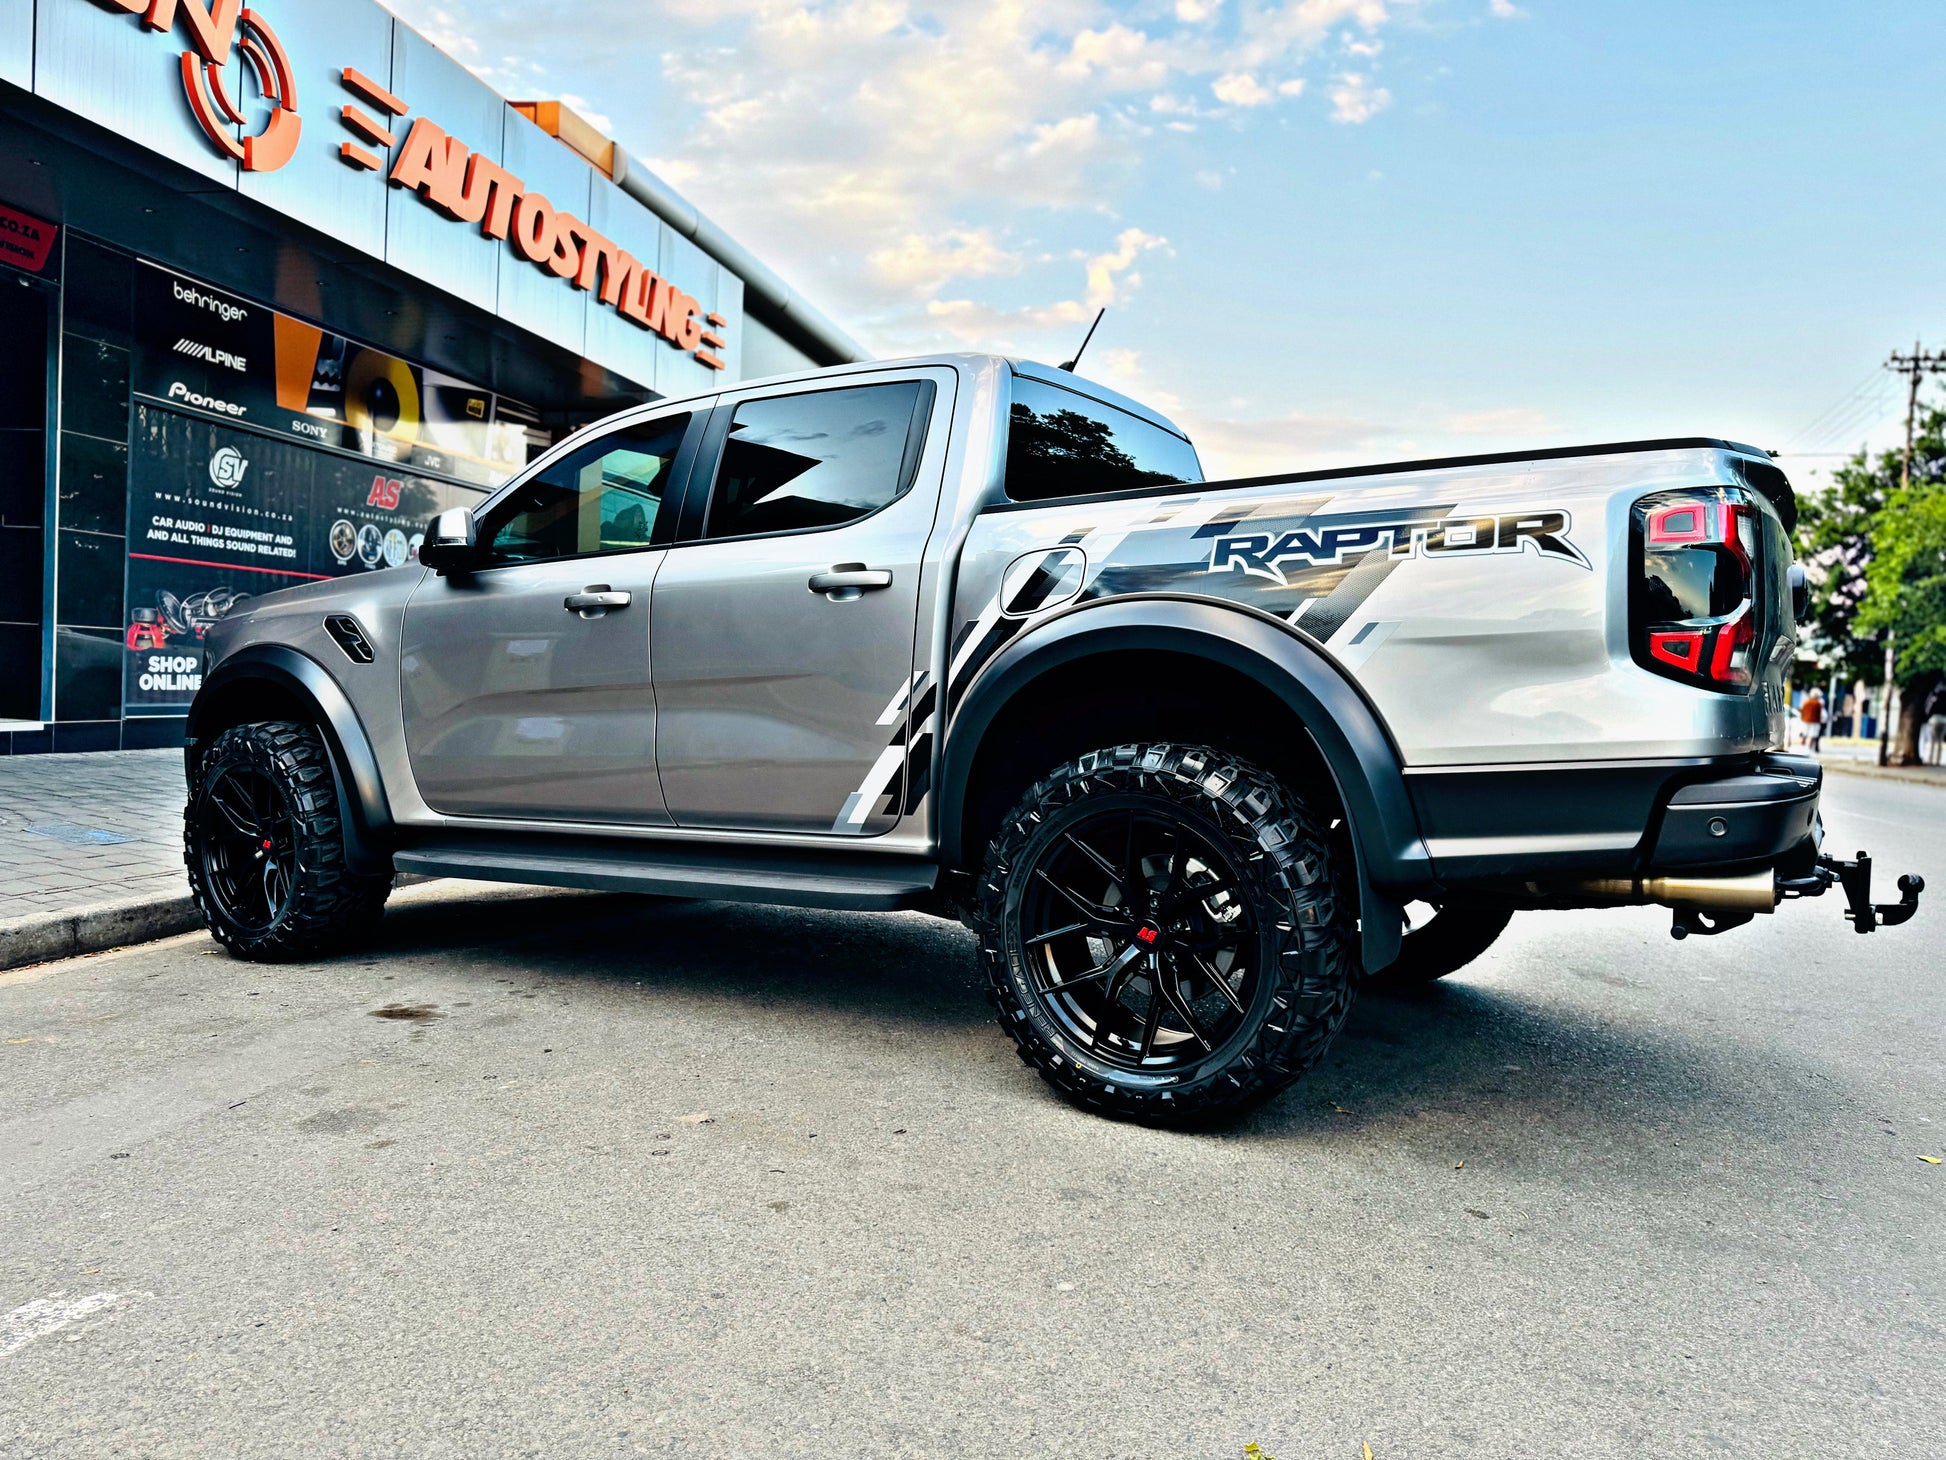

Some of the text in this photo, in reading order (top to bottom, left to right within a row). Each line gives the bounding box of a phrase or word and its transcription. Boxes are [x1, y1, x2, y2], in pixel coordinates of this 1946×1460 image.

[390, 117, 703, 351] AUTOSTYLING
[173, 281, 248, 322] behringer
[168, 381, 247, 416] Pioneer
[292, 420, 328, 439] SONY
[217, 454, 249, 483] SV
[424, 455, 441, 469] JVC
[366, 475, 402, 510] AS
[147, 529, 296, 559] AND ALL THINGS SOUND RELATED!
[152, 516, 293, 546] CAR AUDIO DJ EQUIPMENT AND
[1207, 509, 1593, 586] RAPTOR
[148, 656, 198, 674] SHOP
[139, 673, 203, 691] ONLINE
[1136, 926, 1158, 943] AS
